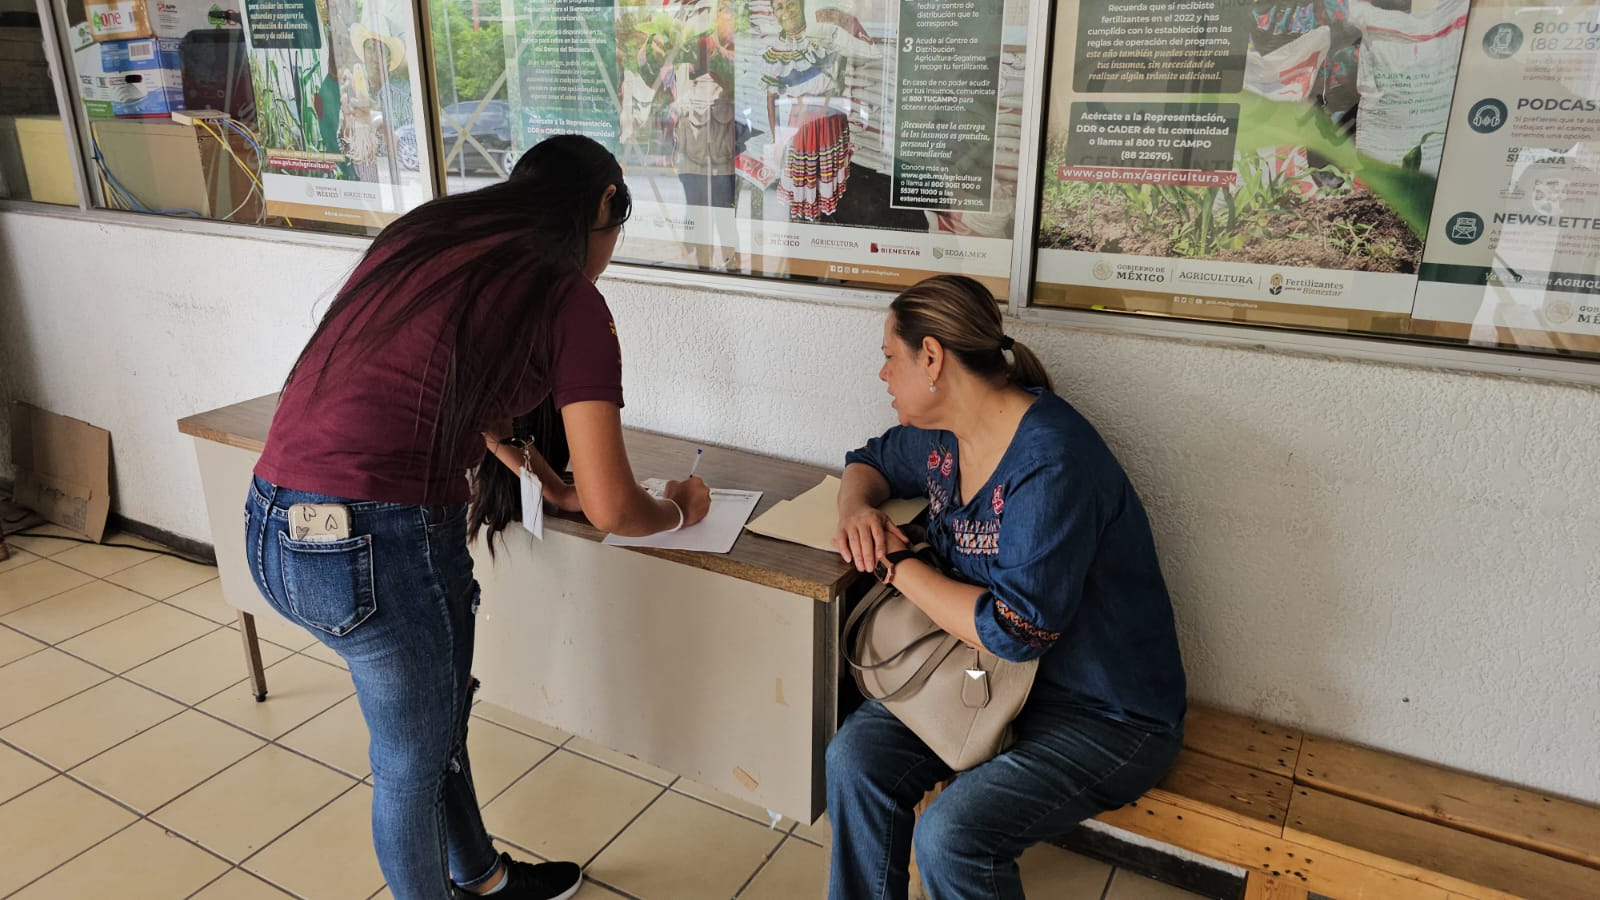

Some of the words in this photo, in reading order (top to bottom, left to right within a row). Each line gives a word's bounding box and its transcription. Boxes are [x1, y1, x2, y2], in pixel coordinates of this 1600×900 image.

[1108, 4, 1147, 12] Recuerda
[1168, 2, 1175, 10] si
[1177, 2, 1215, 10] recibiste
[1101, 15, 1149, 24] fertilizantes
[1164, 14, 1172, 22] el
[1174, 14, 1194, 22] 2022
[1088, 27, 1125, 36] cumplido
[1145, 26, 1152, 34] lo
[1154, 26, 1204, 34] establecido
[1220, 25, 1232, 33] las
[1533, 22, 1568, 33] 800
[903, 37, 913, 52] 3
[1088, 39, 1111, 48] reglas
[1125, 38, 1167, 48] operación
[1169, 38, 1183, 46] del
[1184, 38, 1230, 47] programa,
[1086, 50, 1101, 58] este
[1102, 49, 1118, 58] año
[1119, 49, 1152, 58] también
[1154, 49, 1183, 58] puedes
[1097, 61, 1109, 69] tus
[1110, 61, 1146, 69] insumos,
[1162, 60, 1203, 68] necesidad
[1204, 60, 1215, 68] de
[1088, 72, 1120, 80] realizar
[1120, 72, 1144, 82] algún
[1146, 72, 1178, 80] trámite
[1179, 72, 1222, 80] adicional.
[1081, 112, 1123, 121] Acércate
[1133, 112, 1142, 121] la
[1144, 113, 1227, 123] Representación,
[935, 123, 949, 131] que
[950, 122, 956, 130] la
[958, 123, 985, 132] entrega
[1076, 125, 1097, 133] DDR
[1107, 125, 1141, 134] CADER
[1142, 125, 1155, 134] de
[1157, 126, 1169, 135] tu
[1171, 126, 1229, 136] comunidad
[901, 130, 909, 138] de
[910, 130, 919, 138] los
[921, 131, 949, 139] insumos
[958, 133, 990, 142] gratuita,
[1097, 138, 1123, 146] llama
[1125, 138, 1134, 147] al
[1135, 139, 1155, 147] 800
[1157, 139, 1171, 148] TU
[1173, 140, 1212, 149] CAMPO
[900, 149, 952, 158] intermediarios!
[1121, 151, 1136, 160] (88
[1138, 151, 1173, 162] 22676).
[901, 173, 981, 181] www.gob.mx/agricultura
[1062, 168, 1220, 184] www.gob.mx/agricultura
[810, 238, 859, 248] AGRICULTURA
[880, 248, 920, 256] BIENESTAR
[944, 249, 987, 259] SEGALMEX
[1117, 264, 1154, 272] GOBIERNO
[1116, 271, 1165, 282] MÉXICO
[1179, 271, 1254, 285] AGRICULTURA
[1285, 278, 1344, 290] Fertilizantes
[1302, 288, 1343, 297] Bienestar
